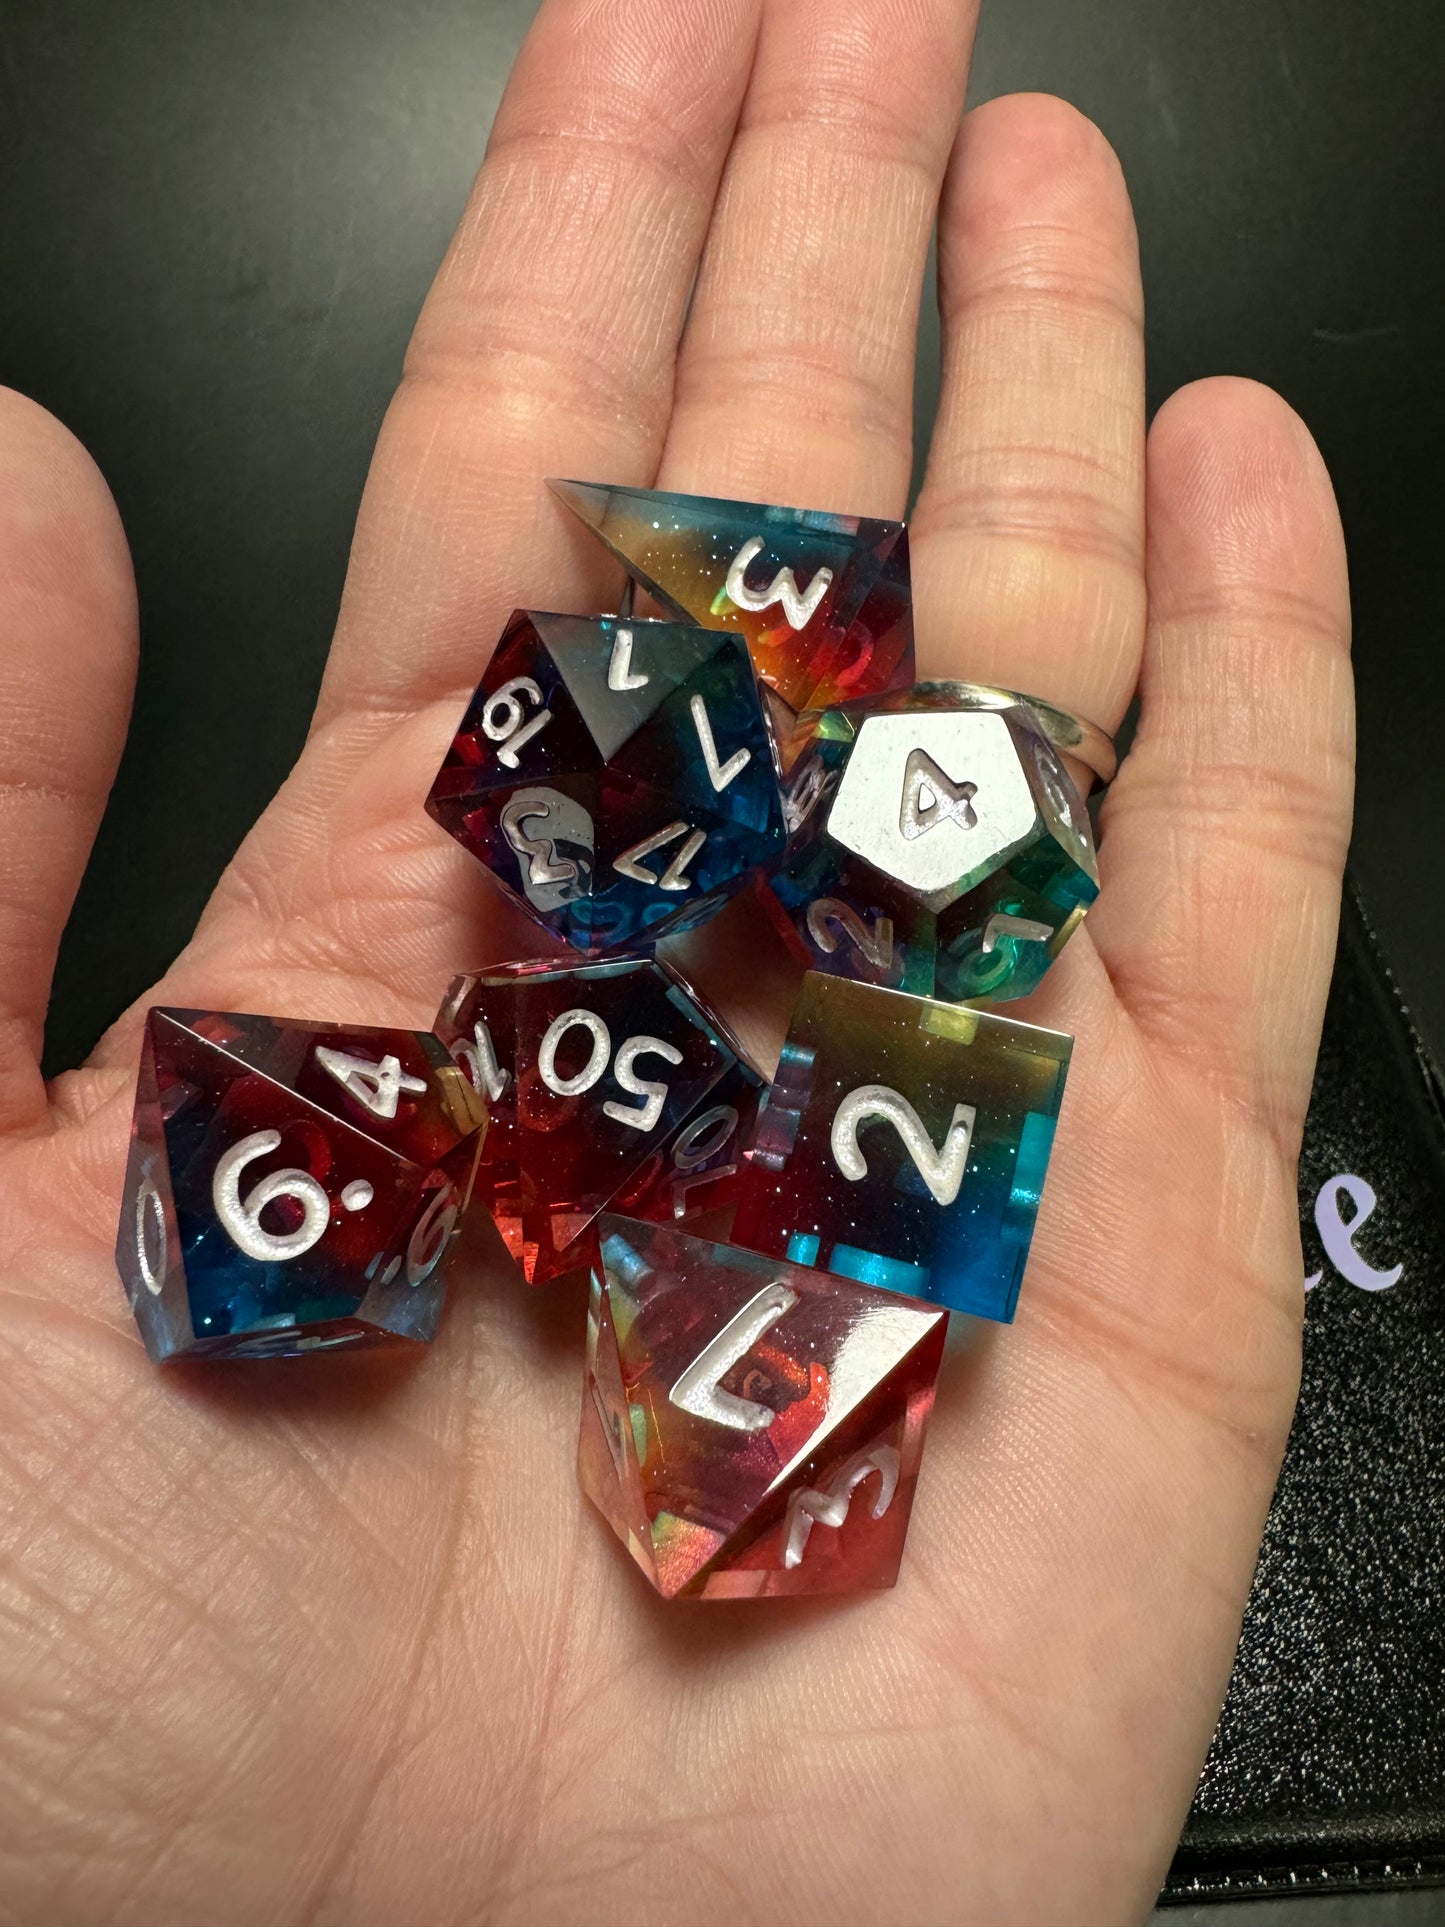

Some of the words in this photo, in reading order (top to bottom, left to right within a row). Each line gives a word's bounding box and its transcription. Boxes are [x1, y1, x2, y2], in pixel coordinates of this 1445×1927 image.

[726, 536, 833, 631] 3
[899, 747, 978, 841] 4
[807, 897, 894, 969] 2
[314, 1045, 428, 1118] 4
[538, 1008, 684, 1132] 50
[831, 1084, 976, 1206] 2
